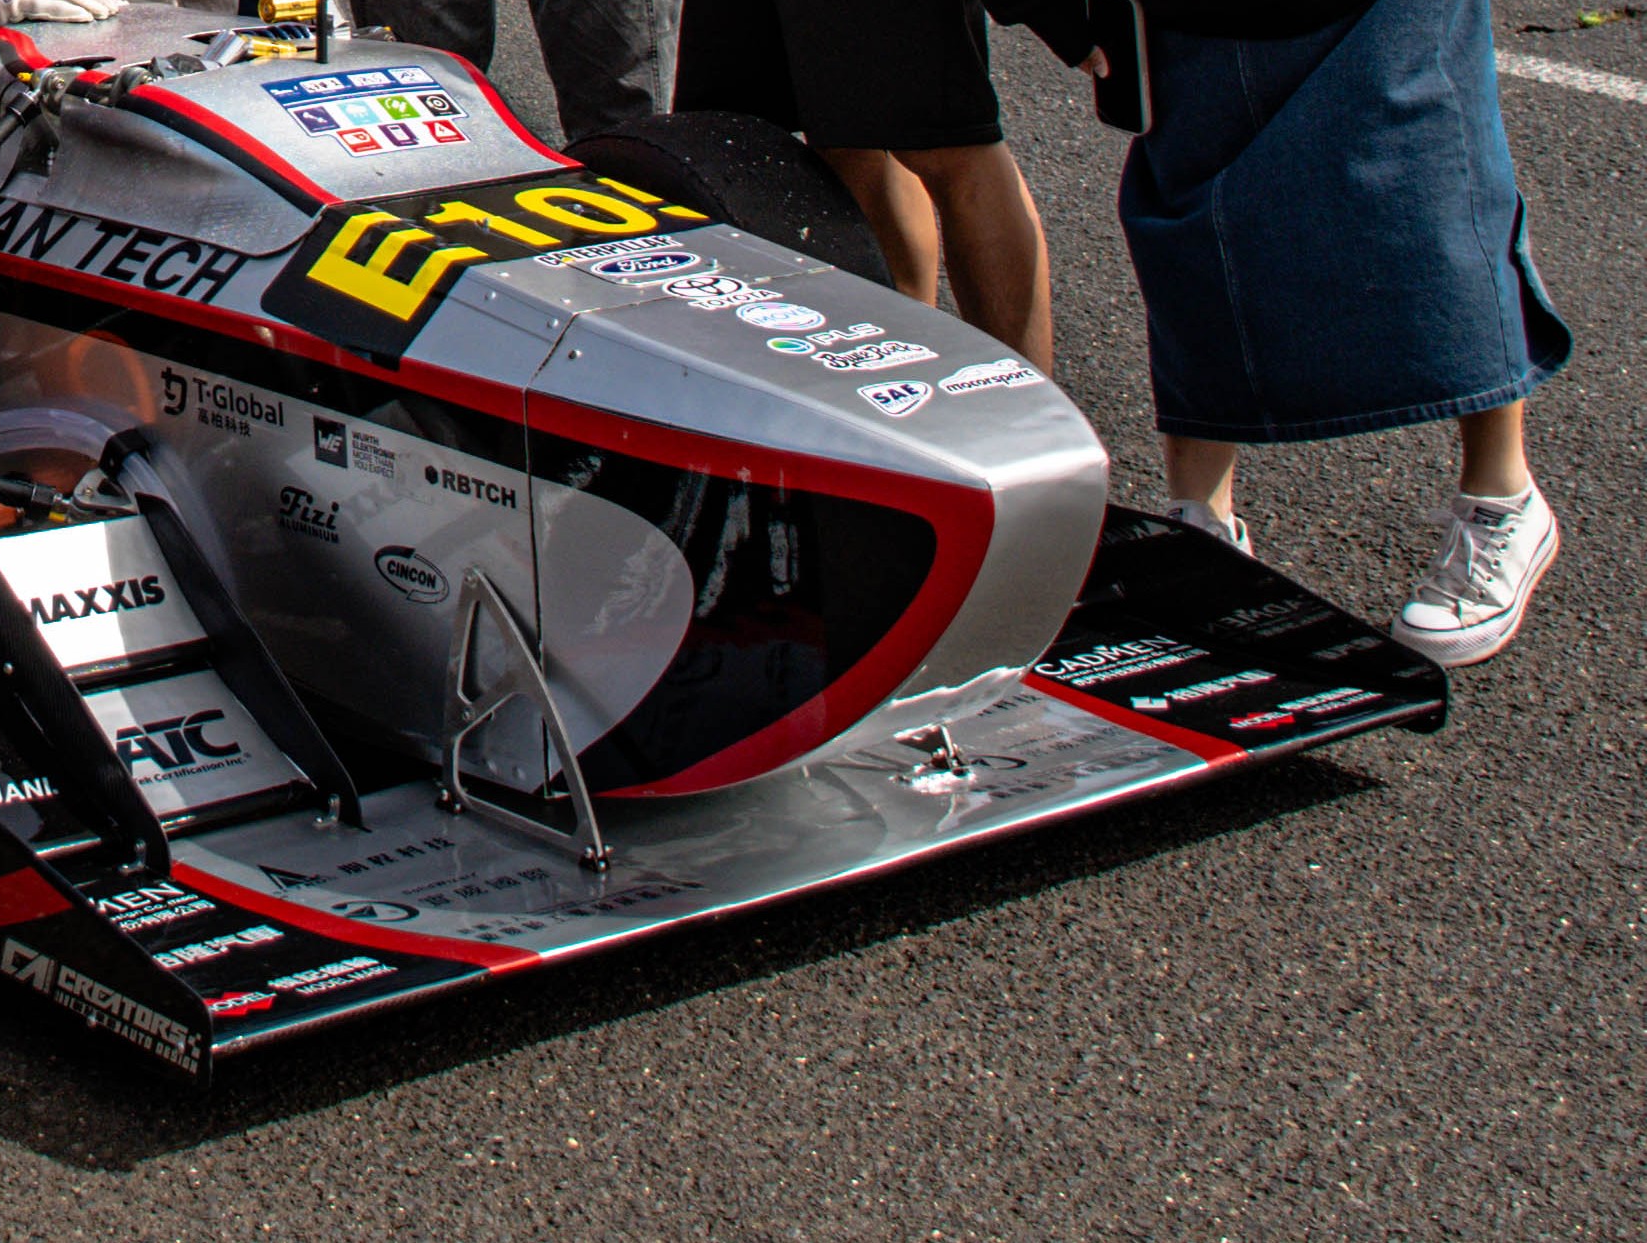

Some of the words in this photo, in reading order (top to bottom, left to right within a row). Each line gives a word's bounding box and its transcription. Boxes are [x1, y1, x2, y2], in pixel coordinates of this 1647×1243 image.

[95, 220, 247, 304] TECH
[539, 236, 677, 265] CATERPILLAR
[617, 255, 679, 273] Ford
[697, 288, 775, 309] TOYOTA
[810, 324, 882, 344] PLS
[872, 383, 920, 405] SAE
[197, 407, 252, 438] 高柏科技
[442, 468, 517, 509] RBTCH
[279, 519, 340, 545] ALUMINIUM
[386, 558, 438, 590] CINCON
[1034, 635, 1179, 676] CADMEN
[154, 760, 225, 783] Certification
[208, 989, 277, 1013] ODEL
